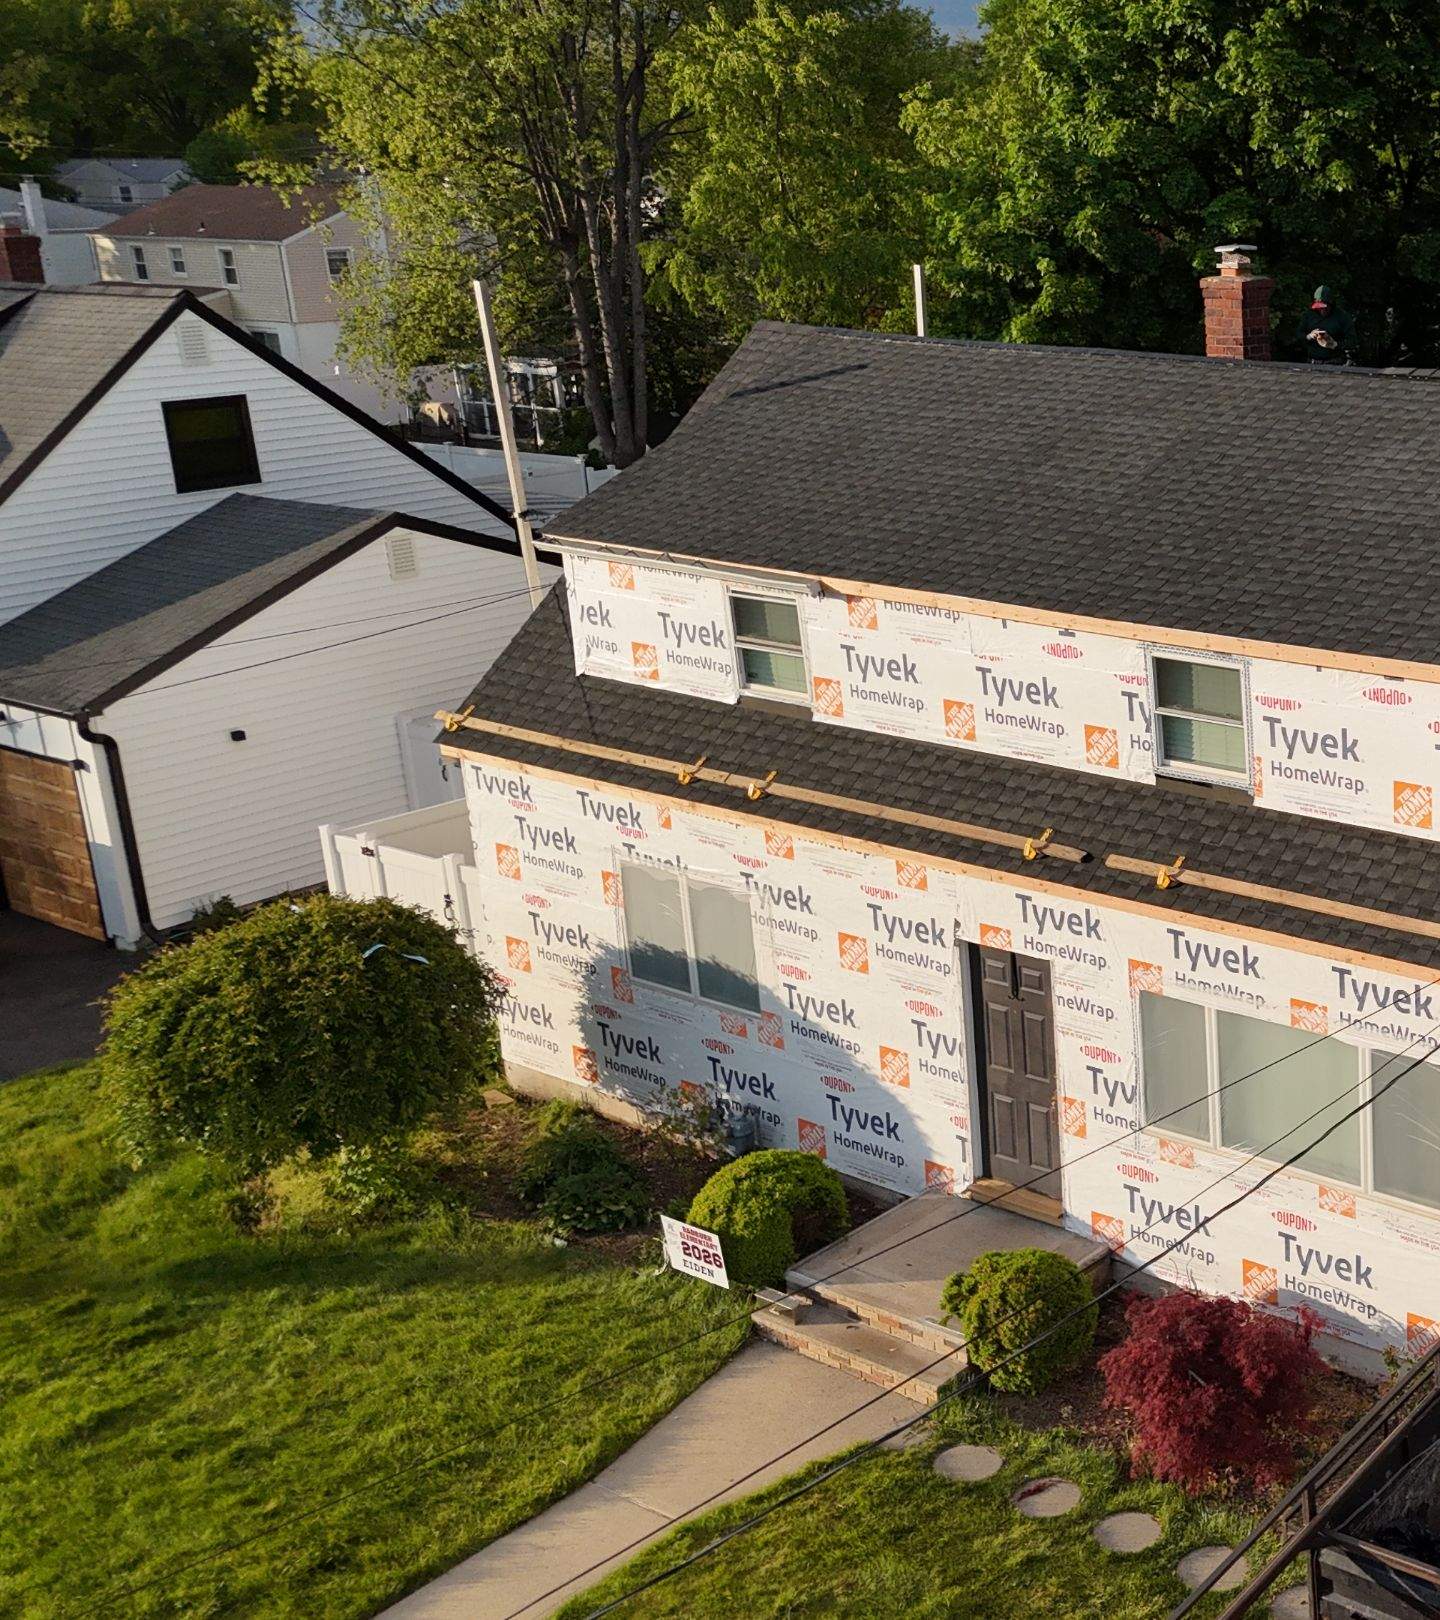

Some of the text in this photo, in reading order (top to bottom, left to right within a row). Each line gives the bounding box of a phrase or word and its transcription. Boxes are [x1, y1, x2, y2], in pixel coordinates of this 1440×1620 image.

[657, 612, 726, 648] Tyvek
[667, 650, 732, 676] HomeWrap
[840, 644, 919, 684] Tyvek
[1046, 643, 1079, 658] DUPONT
[850, 684, 924, 712] HomeWrap
[976, 666, 1060, 708] Tyvek
[1368, 688, 1406, 705] DUPONT
[985, 708, 1065, 738] HomeWrap
[1263, 716, 1360, 762] Tyvek
[1271, 760, 1364, 794] HomeWrap
[514, 815, 578, 854] Tyvek
[523, 851, 583, 879] HomeWrap
[528, 911, 591, 950] Tyvek
[867, 903, 946, 948] Tyvek
[1015, 893, 1103, 941] Tyvek
[537, 947, 597, 975] HomeWrap
[876, 943, 951, 977] HomeWrap
[1024, 935, 1107, 970] HomeWrap
[1166, 928, 1262, 979] Tyvek
[781, 964, 807, 981] DUPONT
[783, 983, 856, 1028] Tyvek
[909, 1000, 939, 1018] DUPONT
[1331, 966, 1434, 1020] Tyvek
[503, 1024, 559, 1054] HomeWrap
[597, 1021, 661, 1064] Tyvek
[791, 1020, 861, 1055] HomeWrap
[1084, 1045, 1117, 1063] DUPONT
[605, 1057, 666, 1087] HomeWrap
[707, 1056, 777, 1101] Tyvek
[824, 1075, 851, 1093] DUPONT
[826, 1094, 901, 1142] Tyvek
[834, 1131, 905, 1168] HomeWrap
[1122, 1164, 1154, 1184] DUPONT
[1123, 1184, 1211, 1238] Tyvek
[1276, 1211, 1312, 1232] DUPONT
[681, 1241, 723, 1269] 2026
[1130, 1224, 1215, 1266] HomeWrap
[1278, 1231, 1374, 1289] Tyvek
[683, 1259, 714, 1278] EIDEN
[1285, 1274, 1377, 1319] HomeWrap
